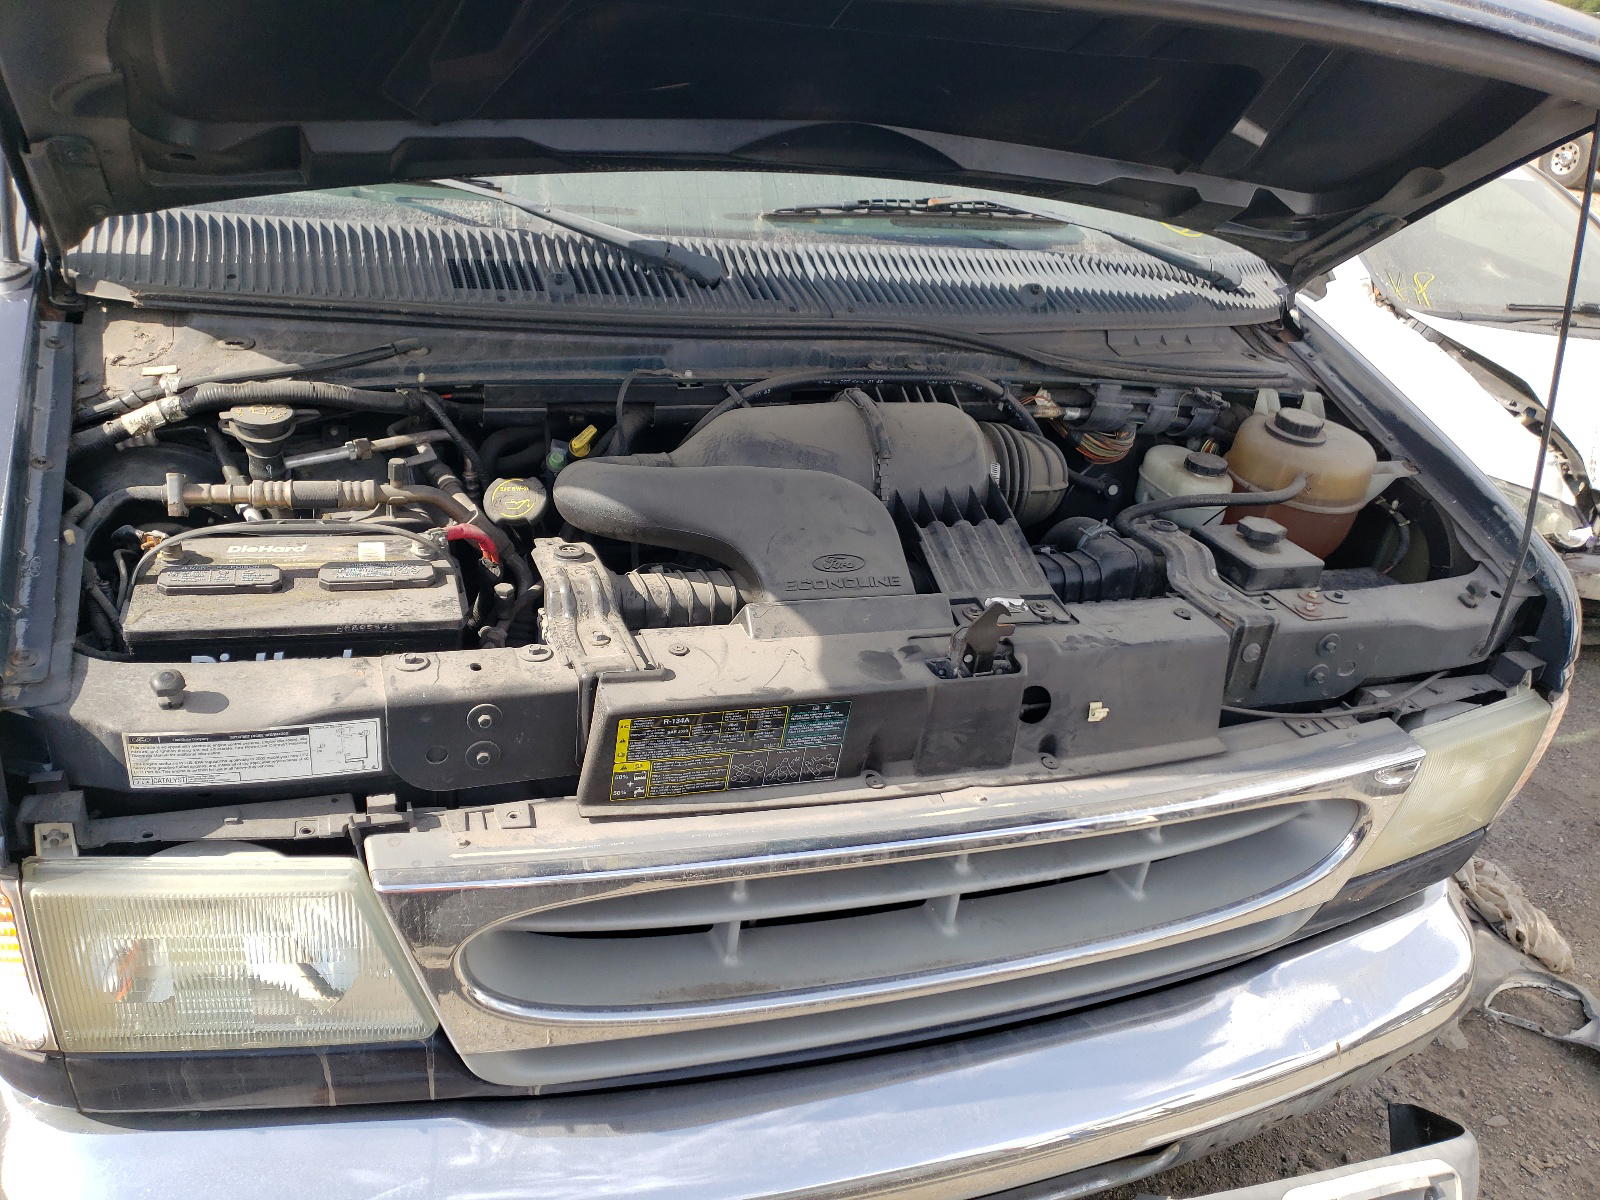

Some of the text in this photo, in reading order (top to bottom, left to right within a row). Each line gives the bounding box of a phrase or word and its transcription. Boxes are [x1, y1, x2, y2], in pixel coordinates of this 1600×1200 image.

[227, 544, 308, 553] DieHard
[785, 577, 901, 591] ECONOLINE
[663, 717, 690, 725] R-134A
[153, 776, 187, 784] CATALYST
